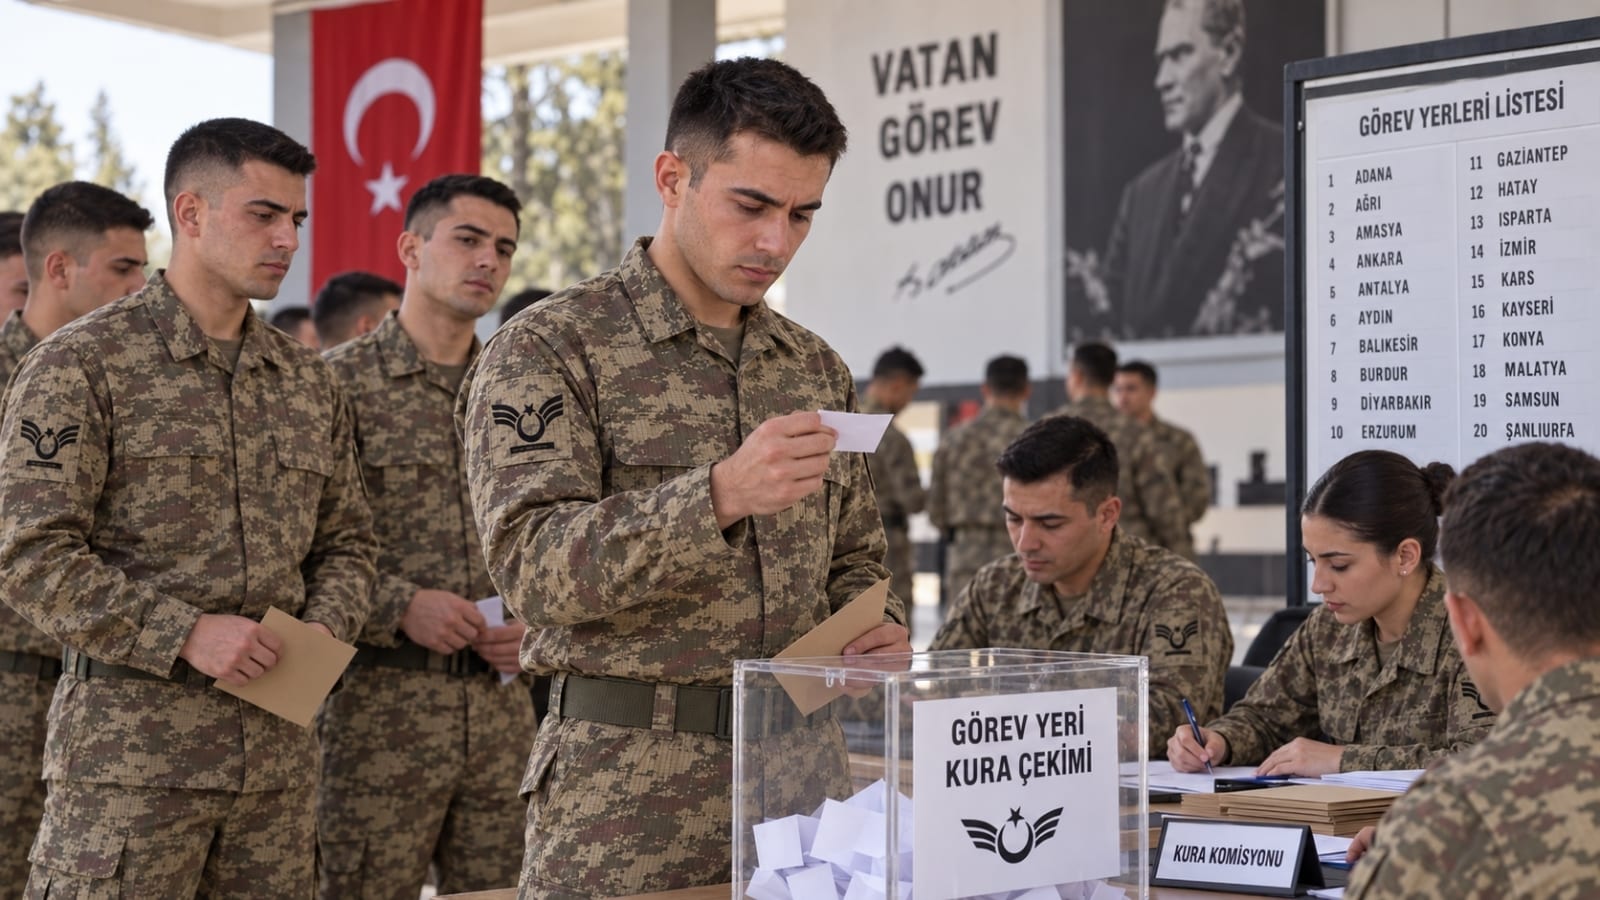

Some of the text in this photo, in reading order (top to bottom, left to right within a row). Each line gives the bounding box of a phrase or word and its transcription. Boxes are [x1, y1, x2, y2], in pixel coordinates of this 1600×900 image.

[872, 32, 998, 96] VATAN
[1359, 79, 1564, 137] GÖREV YERLERİ LİSTESİ
[880, 99, 1000, 160] GÖREV
[1470, 144, 1569, 171] 11 GAZİANTEP
[1328, 165, 1393, 188] 1 ADANA
[886, 170, 982, 224] ONUR
[1470, 178, 1538, 201] 12 HATAY
[1328, 194, 1382, 217] 2 AĞRI
[1470, 207, 1552, 231] 13 ISPARTA
[1328, 221, 1403, 244] 3 AMASYA
[1470, 236, 1537, 260] 14 İZMİR
[1328, 250, 1404, 271] 4 ANKARA
[1329, 279, 1410, 300] 5 ANTALYA
[1471, 269, 1535, 289] 15 KARS
[1329, 309, 1393, 328] 6 AYDIN
[1471, 295, 1554, 319] 16 KAYSERİ
[1330, 333, 1419, 356] 7 BALIKESİR
[1472, 330, 1545, 349] 17 KONYA
[1330, 365, 1408, 384] 8 BURDUR
[1472, 359, 1567, 379] 18 MALATYA
[1331, 392, 1432, 411] 9 DİYARBAKIR
[1473, 391, 1560, 408] 19 SAMSUN
[1330, 424, 1417, 440] 10 ERZURUM
[1473, 422, 1575, 441] 20 ŞANLIURFA
[951, 703, 1084, 746] GÖREV YERİ
[946, 740, 1093, 788] KURA ÇEKİMİ
[1172, 844, 1285, 868] KURA KOMİSYONU
